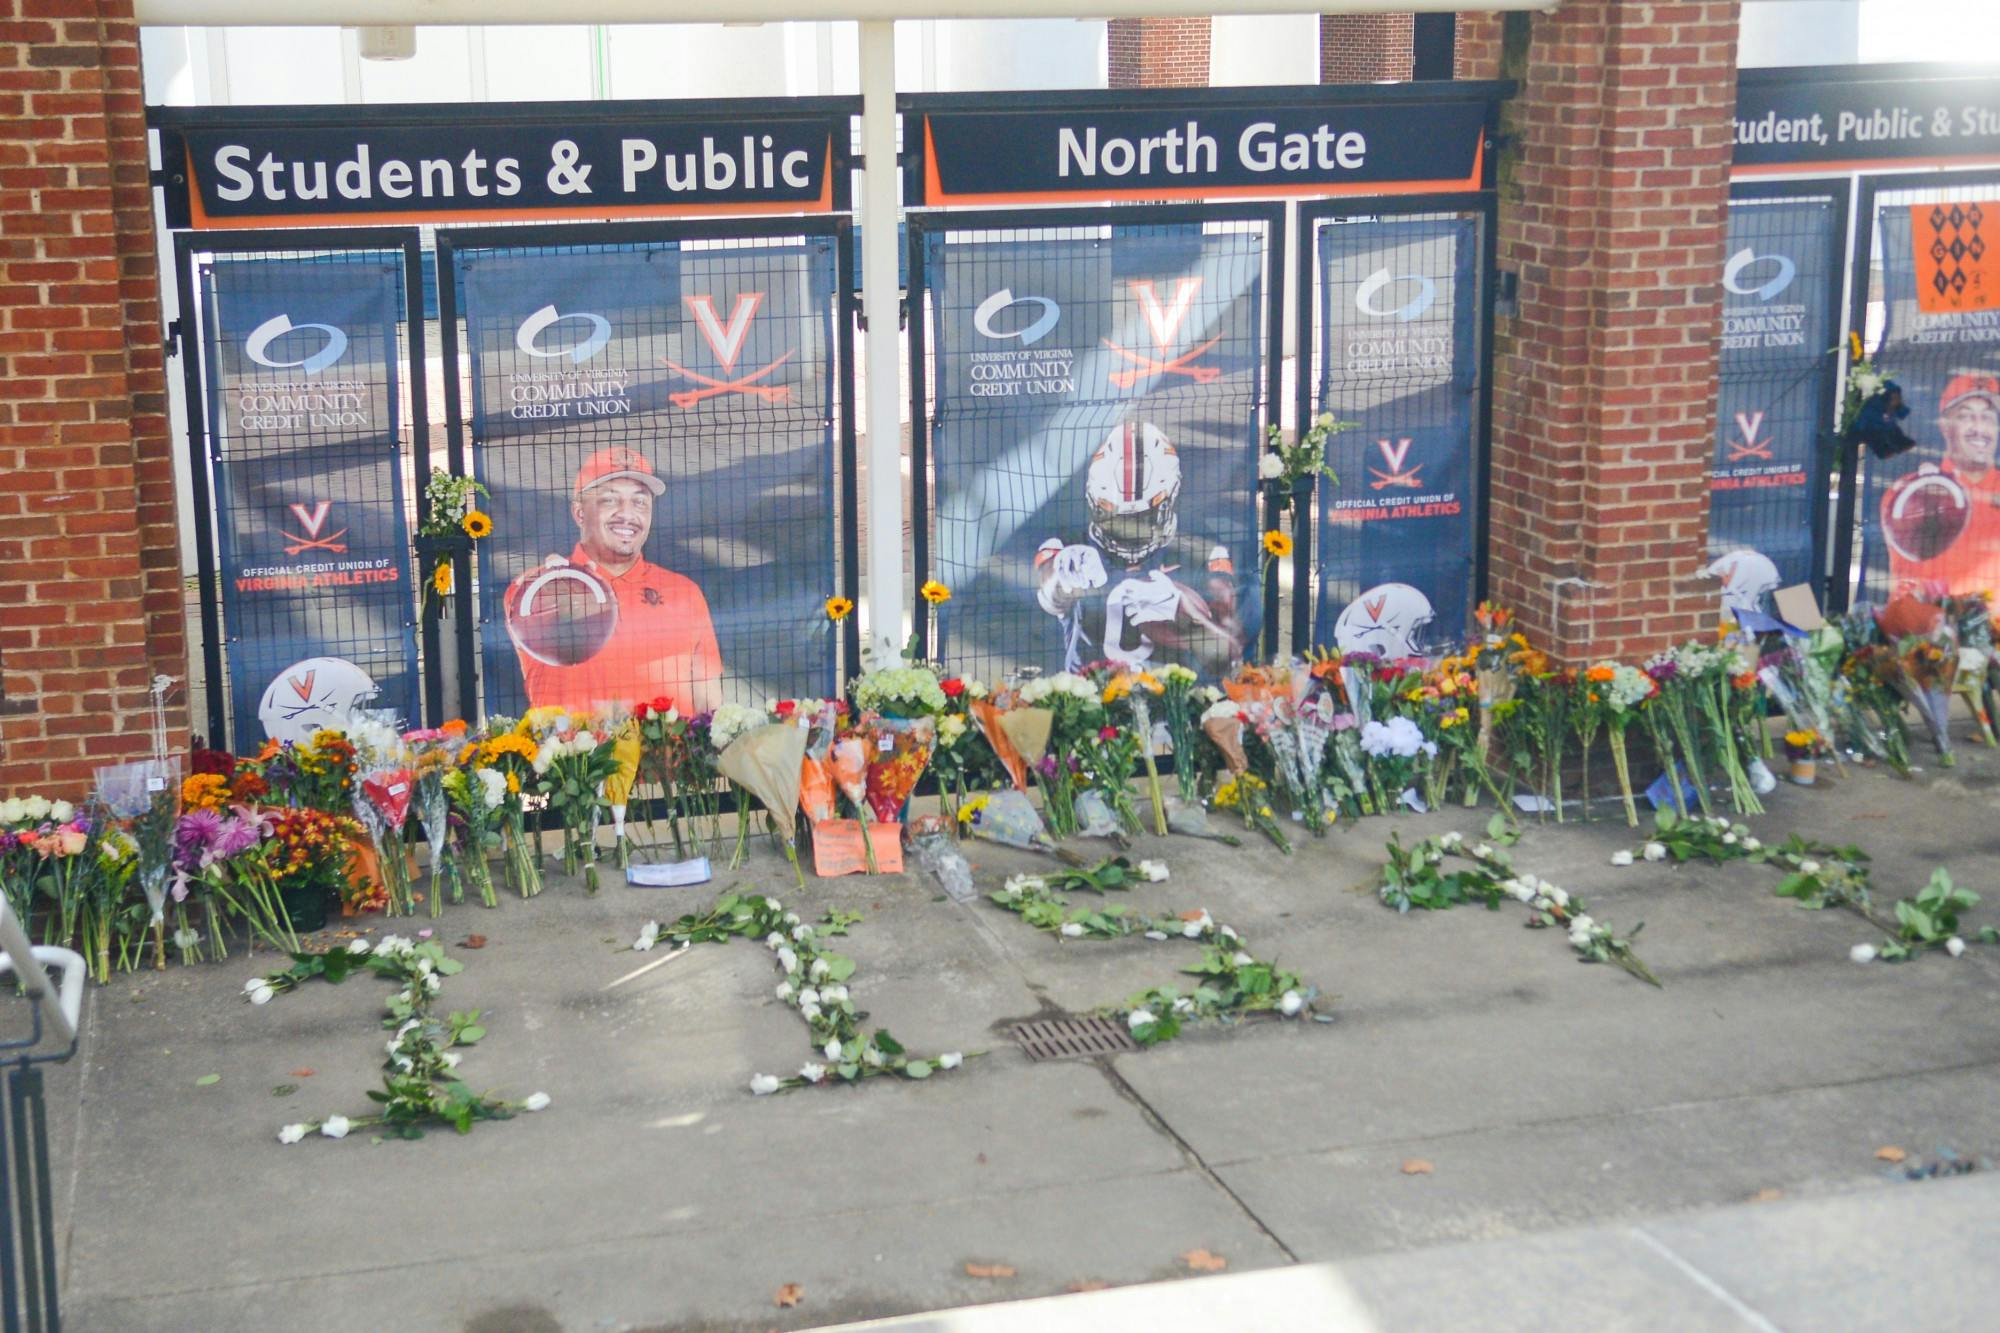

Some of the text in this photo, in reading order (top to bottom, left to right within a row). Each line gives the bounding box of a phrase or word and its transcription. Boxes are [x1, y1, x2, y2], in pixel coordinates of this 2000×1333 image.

[1837, 108, 1923, 142] Public
[1930, 107, 1952, 137] &
[1058, 121, 1366, 177] North Gate
[214, 135, 809, 201] Students & Public
[970, 349, 1073, 362] UNIVERSITY OF VIRGINIA
[1348, 338, 1449, 357] COMMUNITY
[510, 368, 628, 383] UNIVERSITY OF VIRGINIA
[970, 362, 1073, 380] COMMUNITY
[511, 381, 628, 402] COMMUNITY
[970, 380, 1075, 397] CREDIT UNION
[240, 394, 367, 412] COMMUNITY
[511, 400, 632, 419] CREDIT UNION
[240, 412, 368, 430] CREDIT UNION
[1335, 493, 1455, 509] OFFICIAL CREDIT UNION OF
[1391, 503, 1461, 519] ATHLETICS
[243, 559, 390, 578] OFFICIAL CREDIT UNION OF
[236, 569, 399, 593] VIRGINIA ATHLETICS
